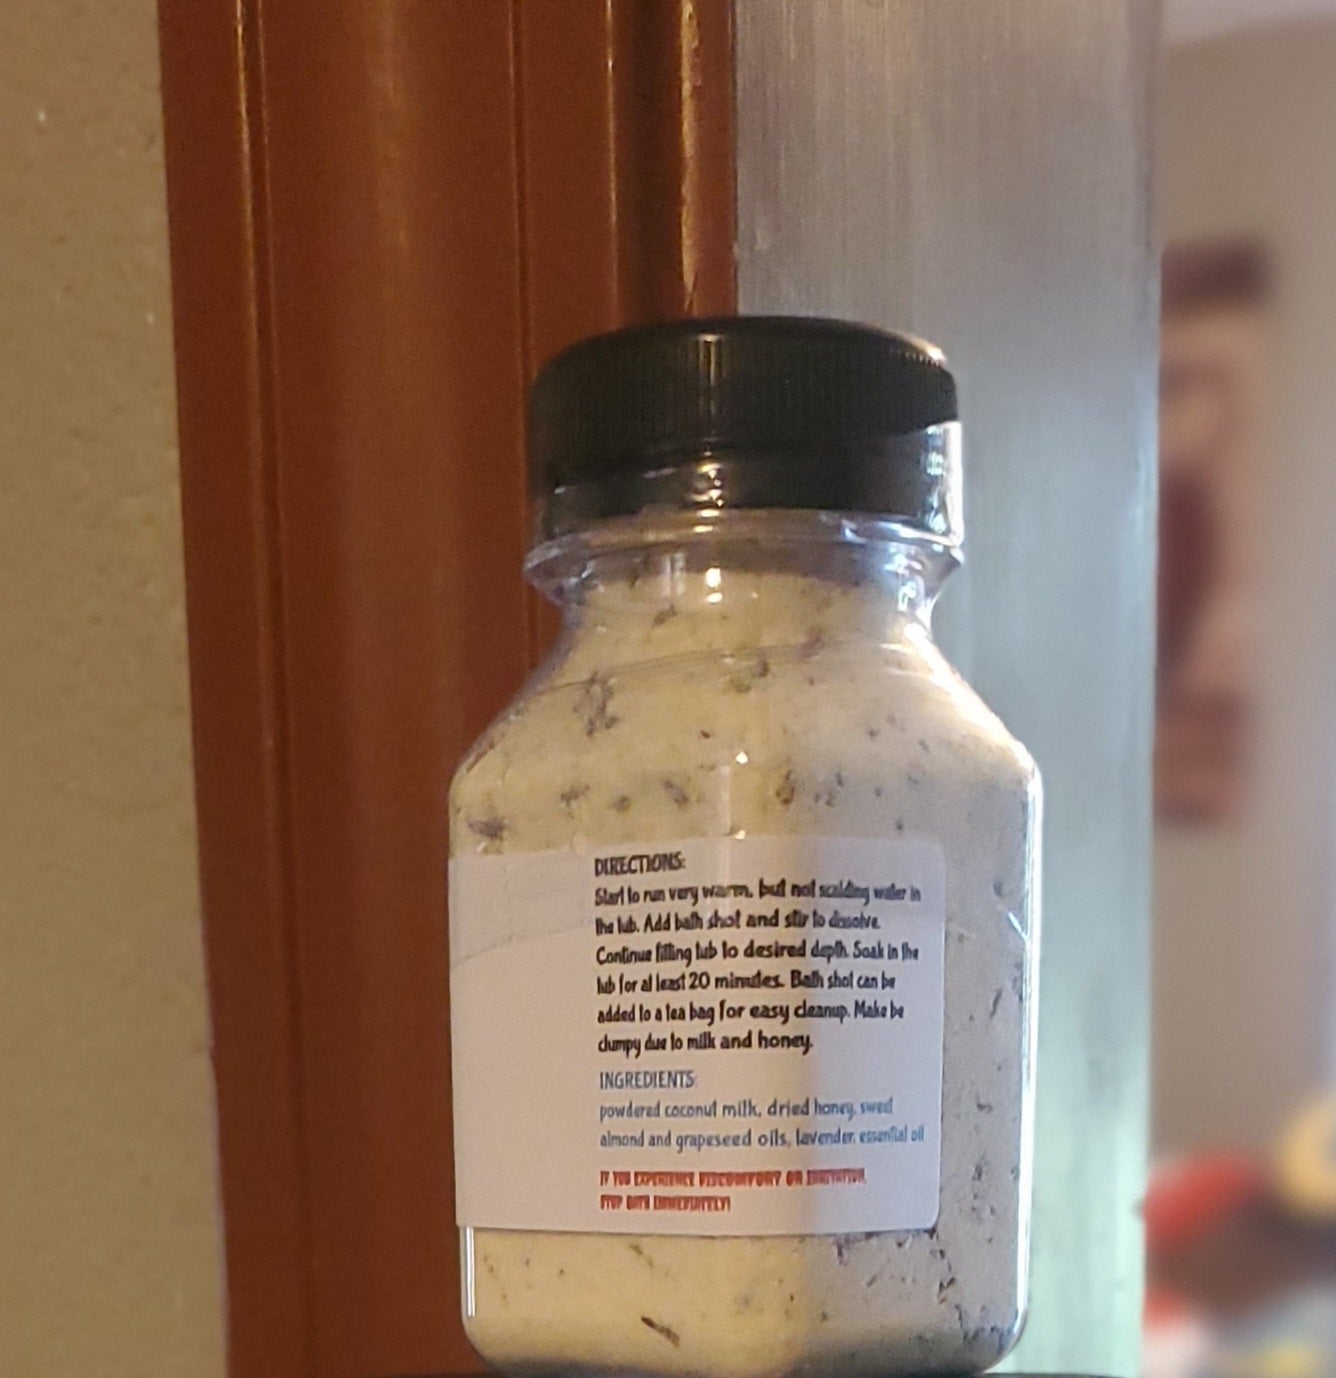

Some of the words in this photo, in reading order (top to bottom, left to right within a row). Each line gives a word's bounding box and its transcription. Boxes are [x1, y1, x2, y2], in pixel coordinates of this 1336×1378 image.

[595, 886, 624, 906] Start
[627, 886, 640, 904] to
[644, 889, 665, 902] run
[669, 887, 698, 906] very
[759, 878, 786, 899] but
[791, 879, 816, 898] not
[819, 879, 870, 906] scalding
[873, 882, 906, 901] water
[910, 885, 921, 901] in
[595, 917, 614, 936] the
[617, 916, 639, 934] tub.
[644, 912, 671, 933] Add
[675, 911, 703, 931] bath
[707, 909, 741, 930] shot
[746, 909, 779, 928] and
[785, 909, 808, 927] stir
[812, 909, 826, 928] to
[829, 910, 880, 929] dissolve.
[596, 945, 652, 966] Continue
[655, 942, 692, 967] filling
[695, 941, 718, 960] tub
[722, 940, 738, 959] to
[744, 940, 806, 958] desired
[853, 940, 884, 959] Soak
[887, 942, 898, 960] in
[901, 941, 919, 961] the
[597, 974, 615, 994] tub
[619, 972, 637, 995] for
[641, 973, 652, 992] at
[656, 972, 686, 991] least
[689, 972, 710, 990] 20
[790, 969, 824, 988] Bath
[827, 970, 854, 989] shot
[857, 975, 878, 988] can
[881, 971, 896, 989] be
[597, 1003, 636, 1023] added
[639, 1003, 651, 1022] to
[655, 1009, 662, 1022] a
[666, 1003, 686, 1022] tea
[689, 1001, 715, 1026] bag
[719, 999, 745, 1021] for
[750, 1004, 789, 1025] easy
[793, 999, 850, 1024] cleanup.
[854, 999, 887, 1020] Make
[890, 999, 905, 1019] be
[598, 1033, 641, 1058] clumpy
[644, 1032, 667, 1051] due
[670, 1031, 683, 1051] to
[687, 1031, 716, 1050] milk
[720, 1029, 752, 1049] and
[758, 1030, 813, 1055] honey.
[600, 1100, 660, 1123] powdered
[664, 1099, 717, 1118] coconut
[722, 1099, 762, 1118] milk,
[767, 1097, 809, 1117] dried
[860, 1097, 893, 1114] sweet
[600, 1130, 644, 1147] almond
[648, 1130, 671, 1147] and
[676, 1129, 751, 1154] grapeseed
[758, 1128, 791, 1147] oils,
[859, 1124, 907, 1143] essential
[911, 1125, 925, 1142] oil
[613, 1171, 631, 1187] YOU
[634, 1171, 695, 1187] EXPERIENCE
[699, 1170, 781, 1187] DISCOMFORT
